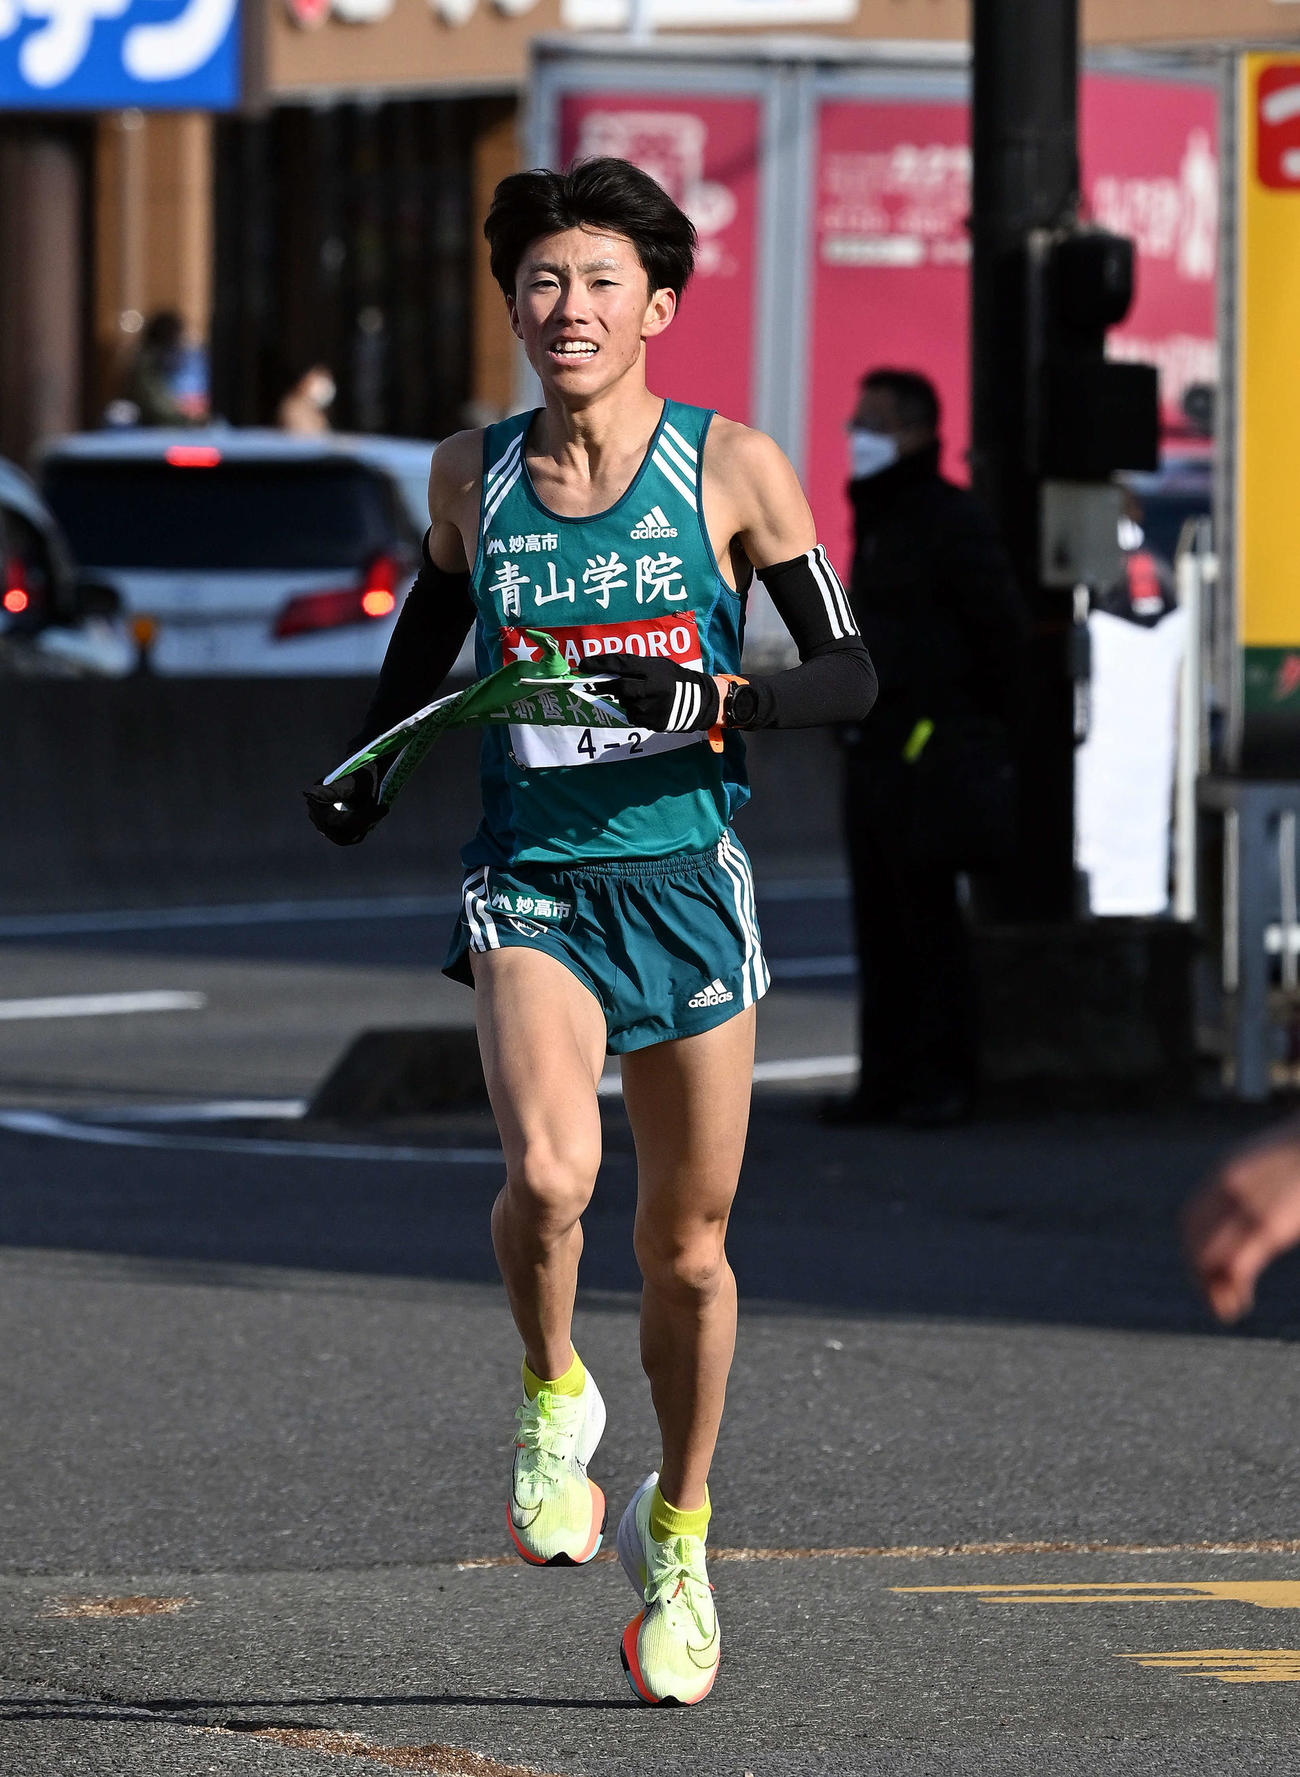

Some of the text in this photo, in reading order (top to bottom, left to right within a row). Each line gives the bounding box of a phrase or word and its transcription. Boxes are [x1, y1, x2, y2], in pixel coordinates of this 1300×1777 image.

[509, 533, 558, 553] 妙高市
[630, 527, 678, 540] adidas
[488, 551, 688, 618] 青山学院
[556, 626, 691, 671] APPORO
[516, 895, 571, 919] 妙高市
[688, 991, 733, 1008] adidas
